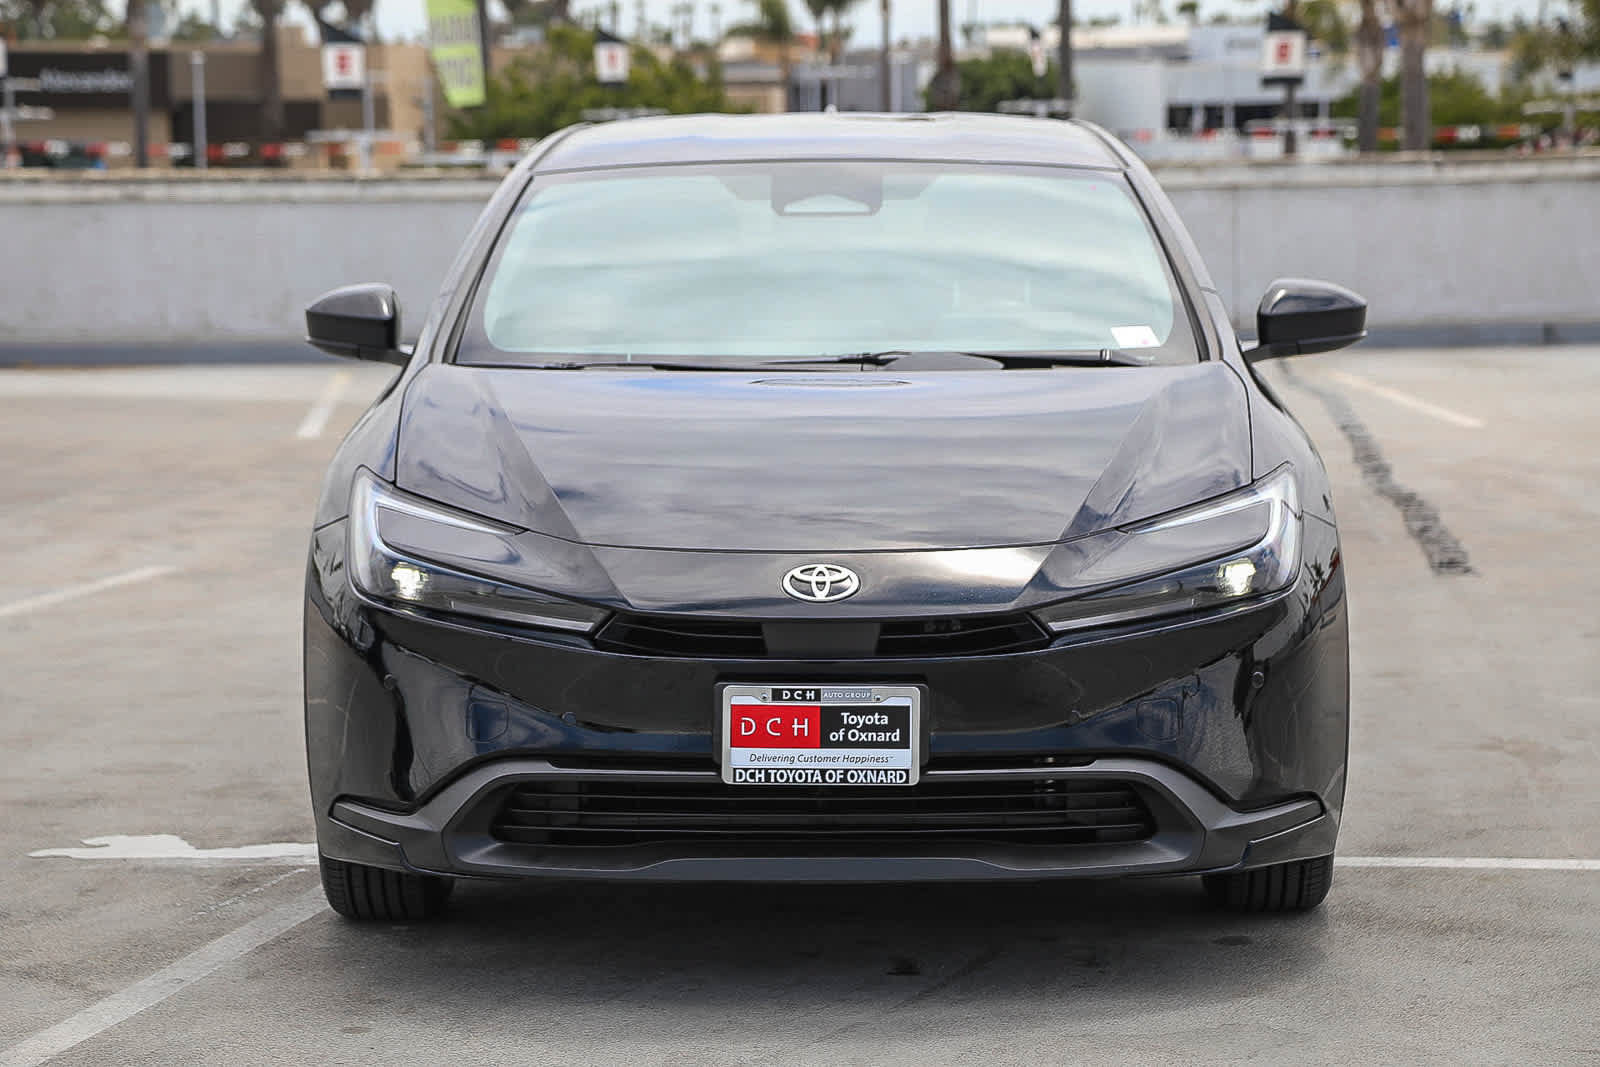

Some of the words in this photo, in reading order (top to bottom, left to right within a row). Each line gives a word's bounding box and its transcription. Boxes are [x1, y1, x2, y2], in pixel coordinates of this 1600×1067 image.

[782, 689, 815, 700] DCH
[824, 691, 845, 699] AUTO
[845, 691, 871, 699] GROUP
[740, 717, 809, 737] DCH
[841, 712, 889, 728] Toyota
[829, 728, 846, 742] of
[847, 729, 900, 742] Oxnard
[749, 753, 795, 765] Delivering
[797, 754, 840, 763] Customer
[735, 769, 765, 783] DCH
[767, 770, 823, 783] TOYOTA
[825, 770, 844, 783] OF
[846, 770, 907, 784] OXNARD
